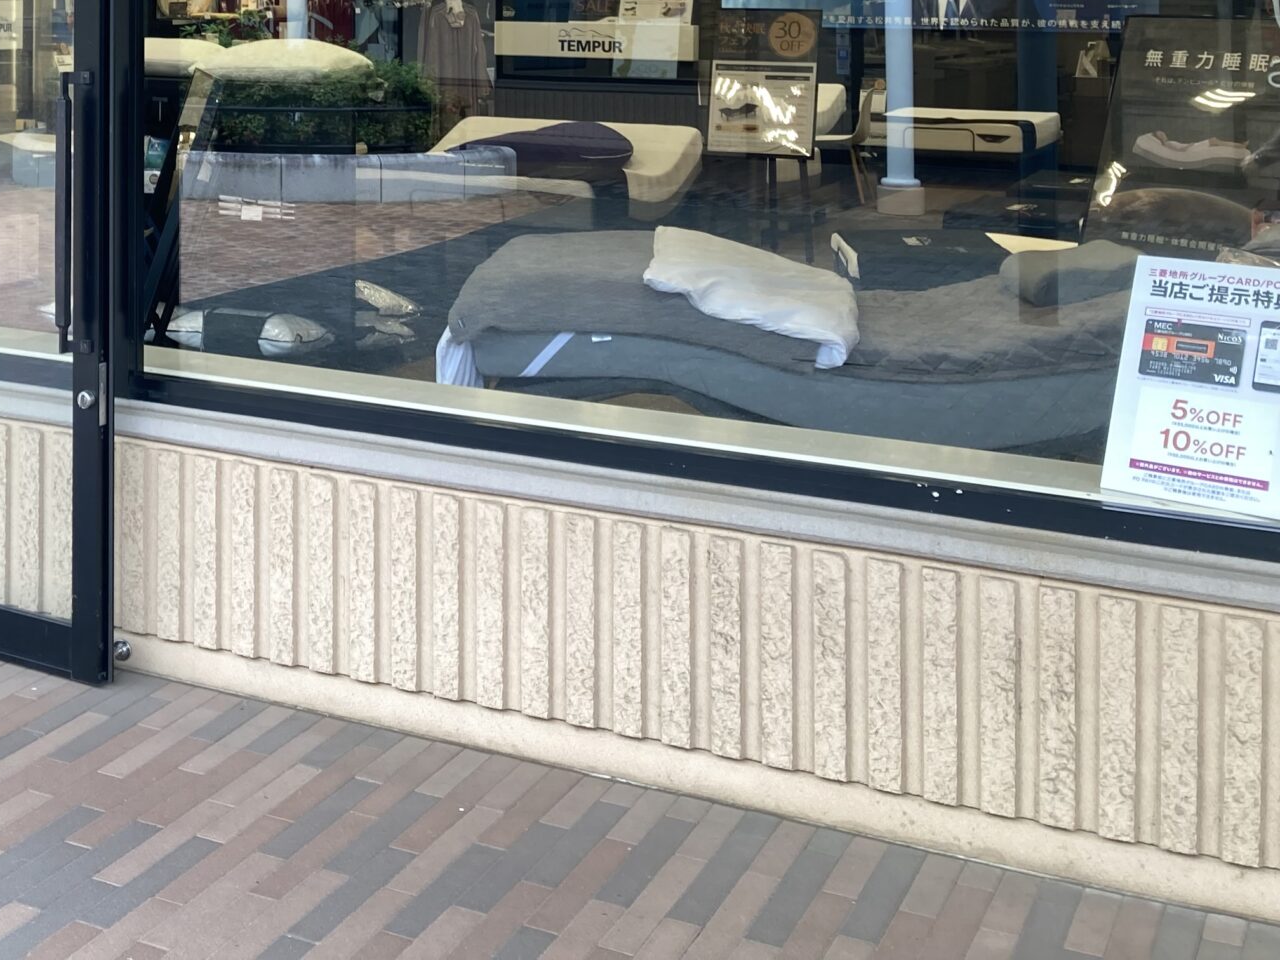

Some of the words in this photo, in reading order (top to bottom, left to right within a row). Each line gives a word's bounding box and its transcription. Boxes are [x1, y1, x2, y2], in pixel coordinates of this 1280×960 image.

[775, 21, 801, 39] 30
[558, 39, 623, 54] TEMPUR
[779, 41, 804, 52] OFF
[1144, 49, 1270, 72] 無重力睡眠
[1154, 321, 1173, 330] MEC
[1213, 374, 1236, 385] VISA
[1171, 398, 1244, 428] 5%OFF
[1160, 428, 1247, 461] 10%OFF
